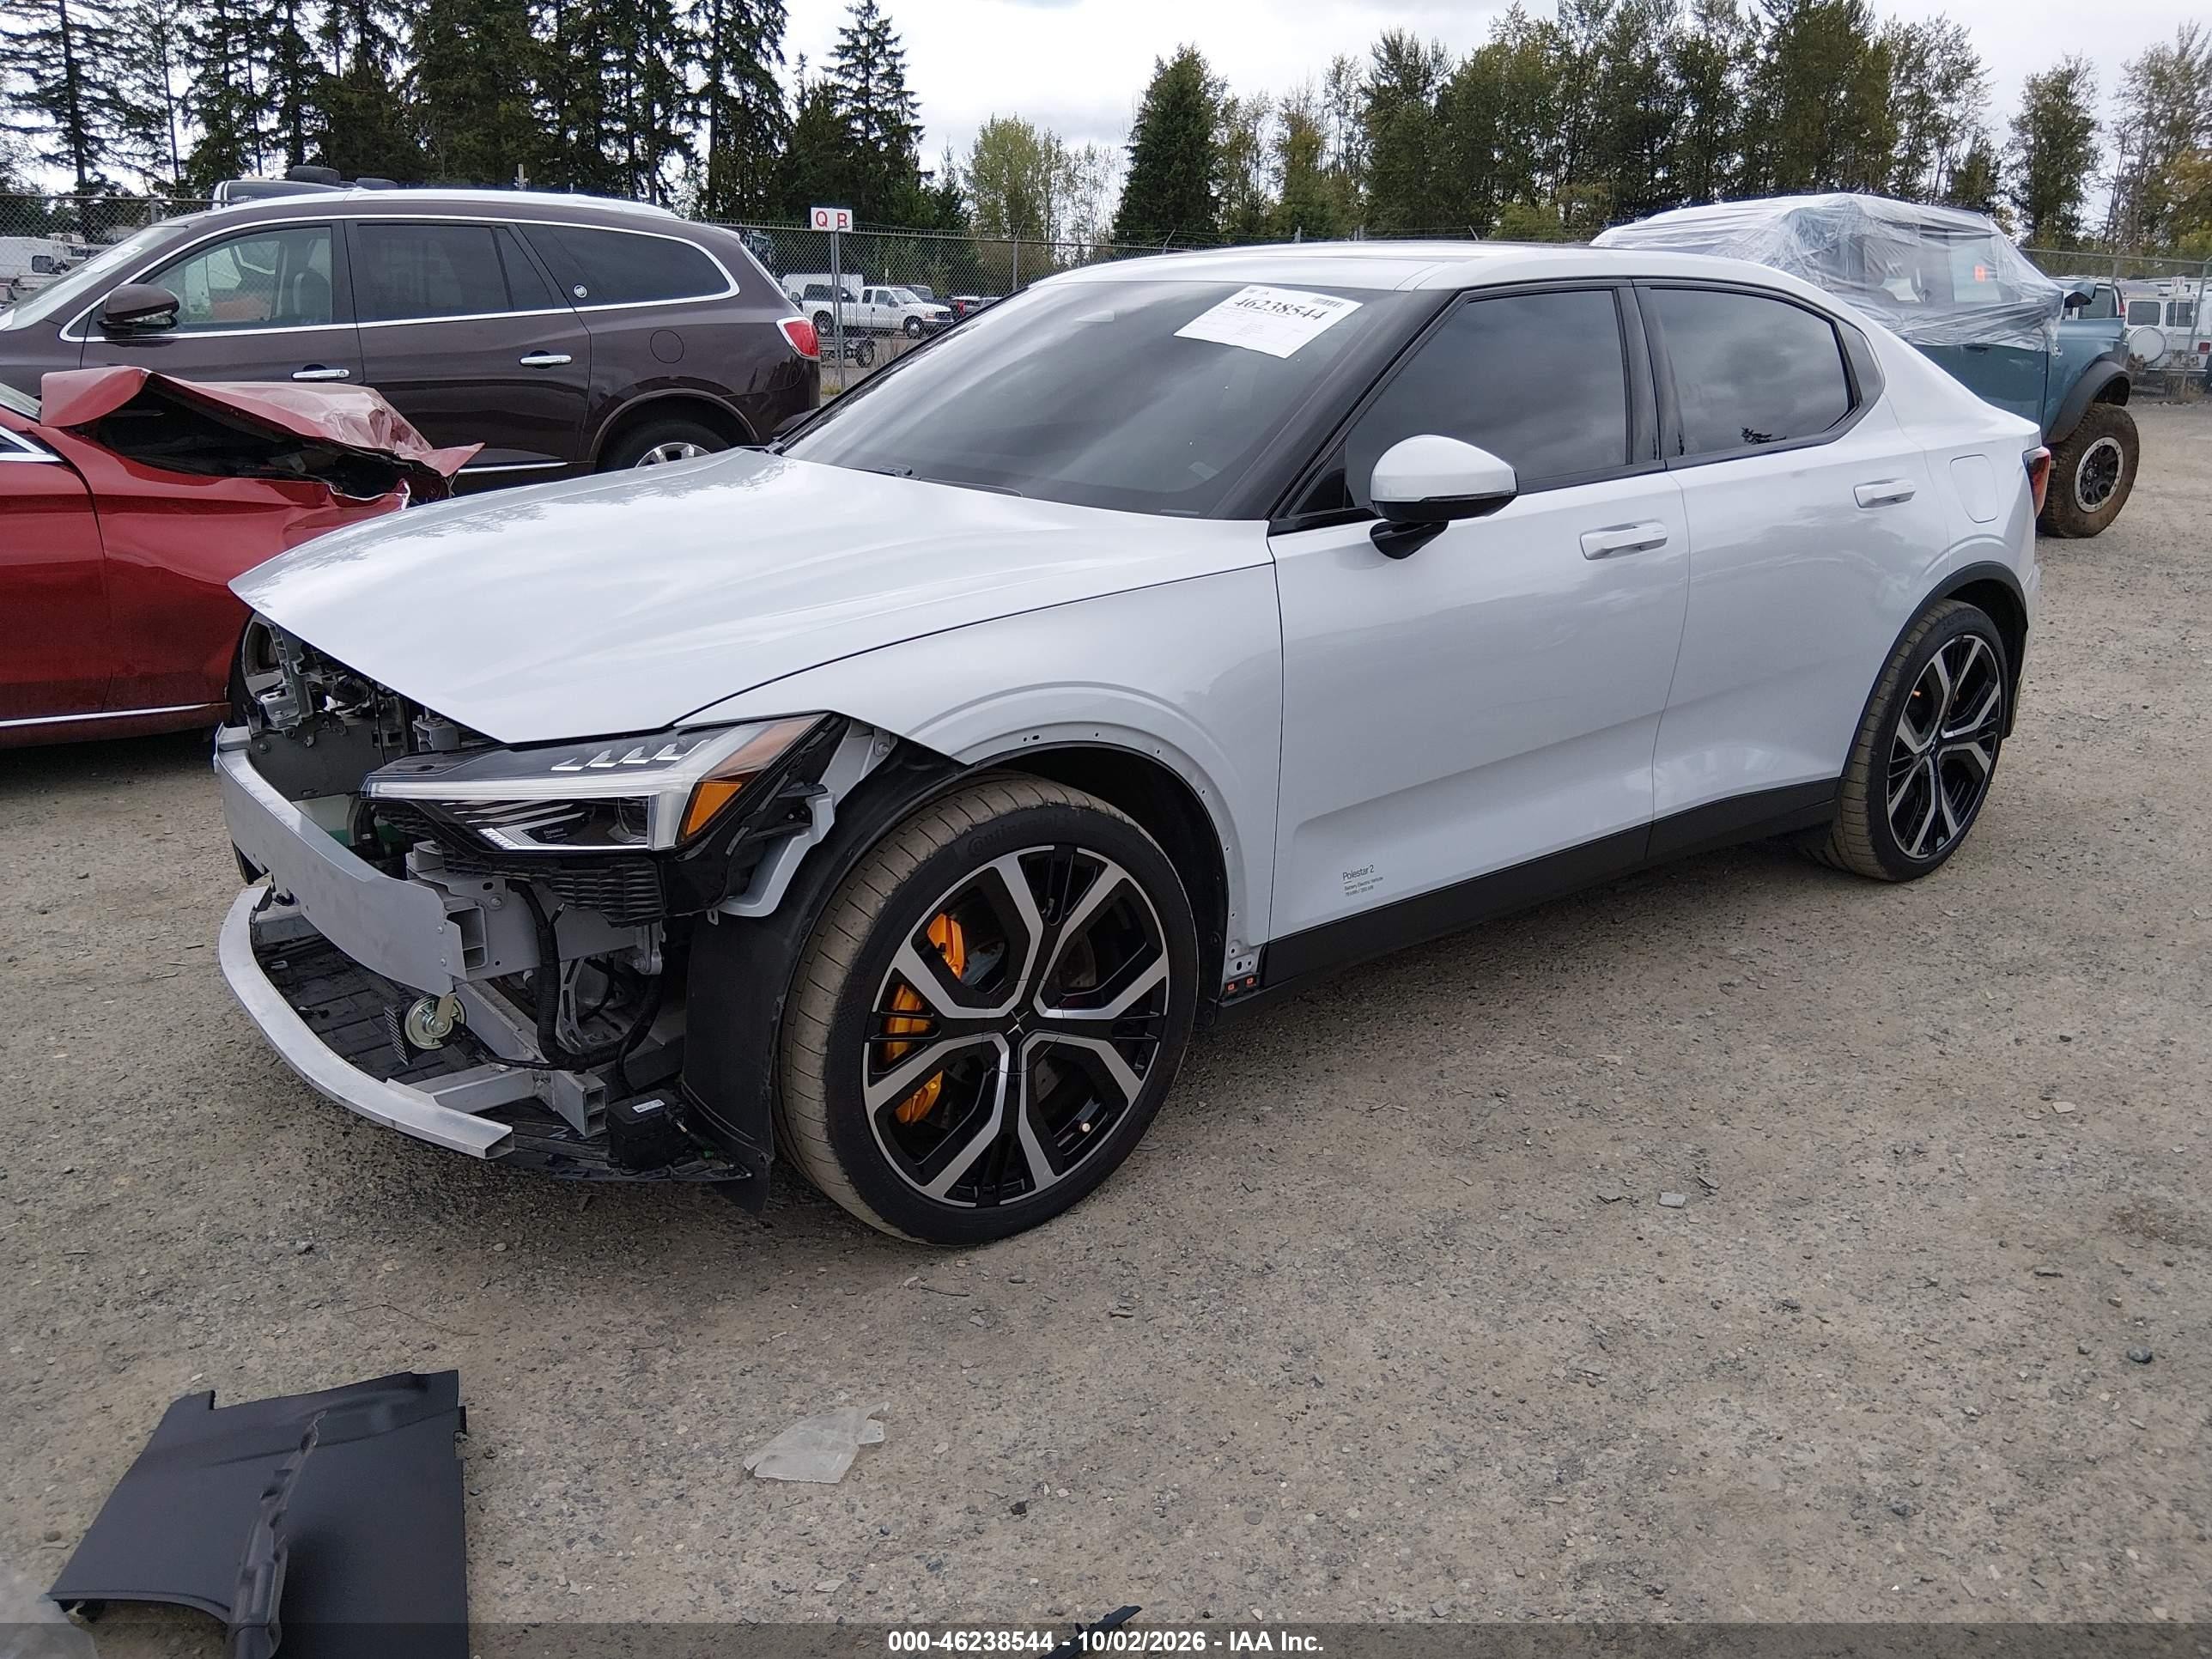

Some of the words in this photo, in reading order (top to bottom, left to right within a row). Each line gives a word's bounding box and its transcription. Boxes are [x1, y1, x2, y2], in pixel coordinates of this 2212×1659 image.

[815, 210, 828, 228] Q
[1234, 297, 1329, 321] 46238544
[1342, 867, 1369, 881] Polestar
[1369, 864, 1375, 873] 2
